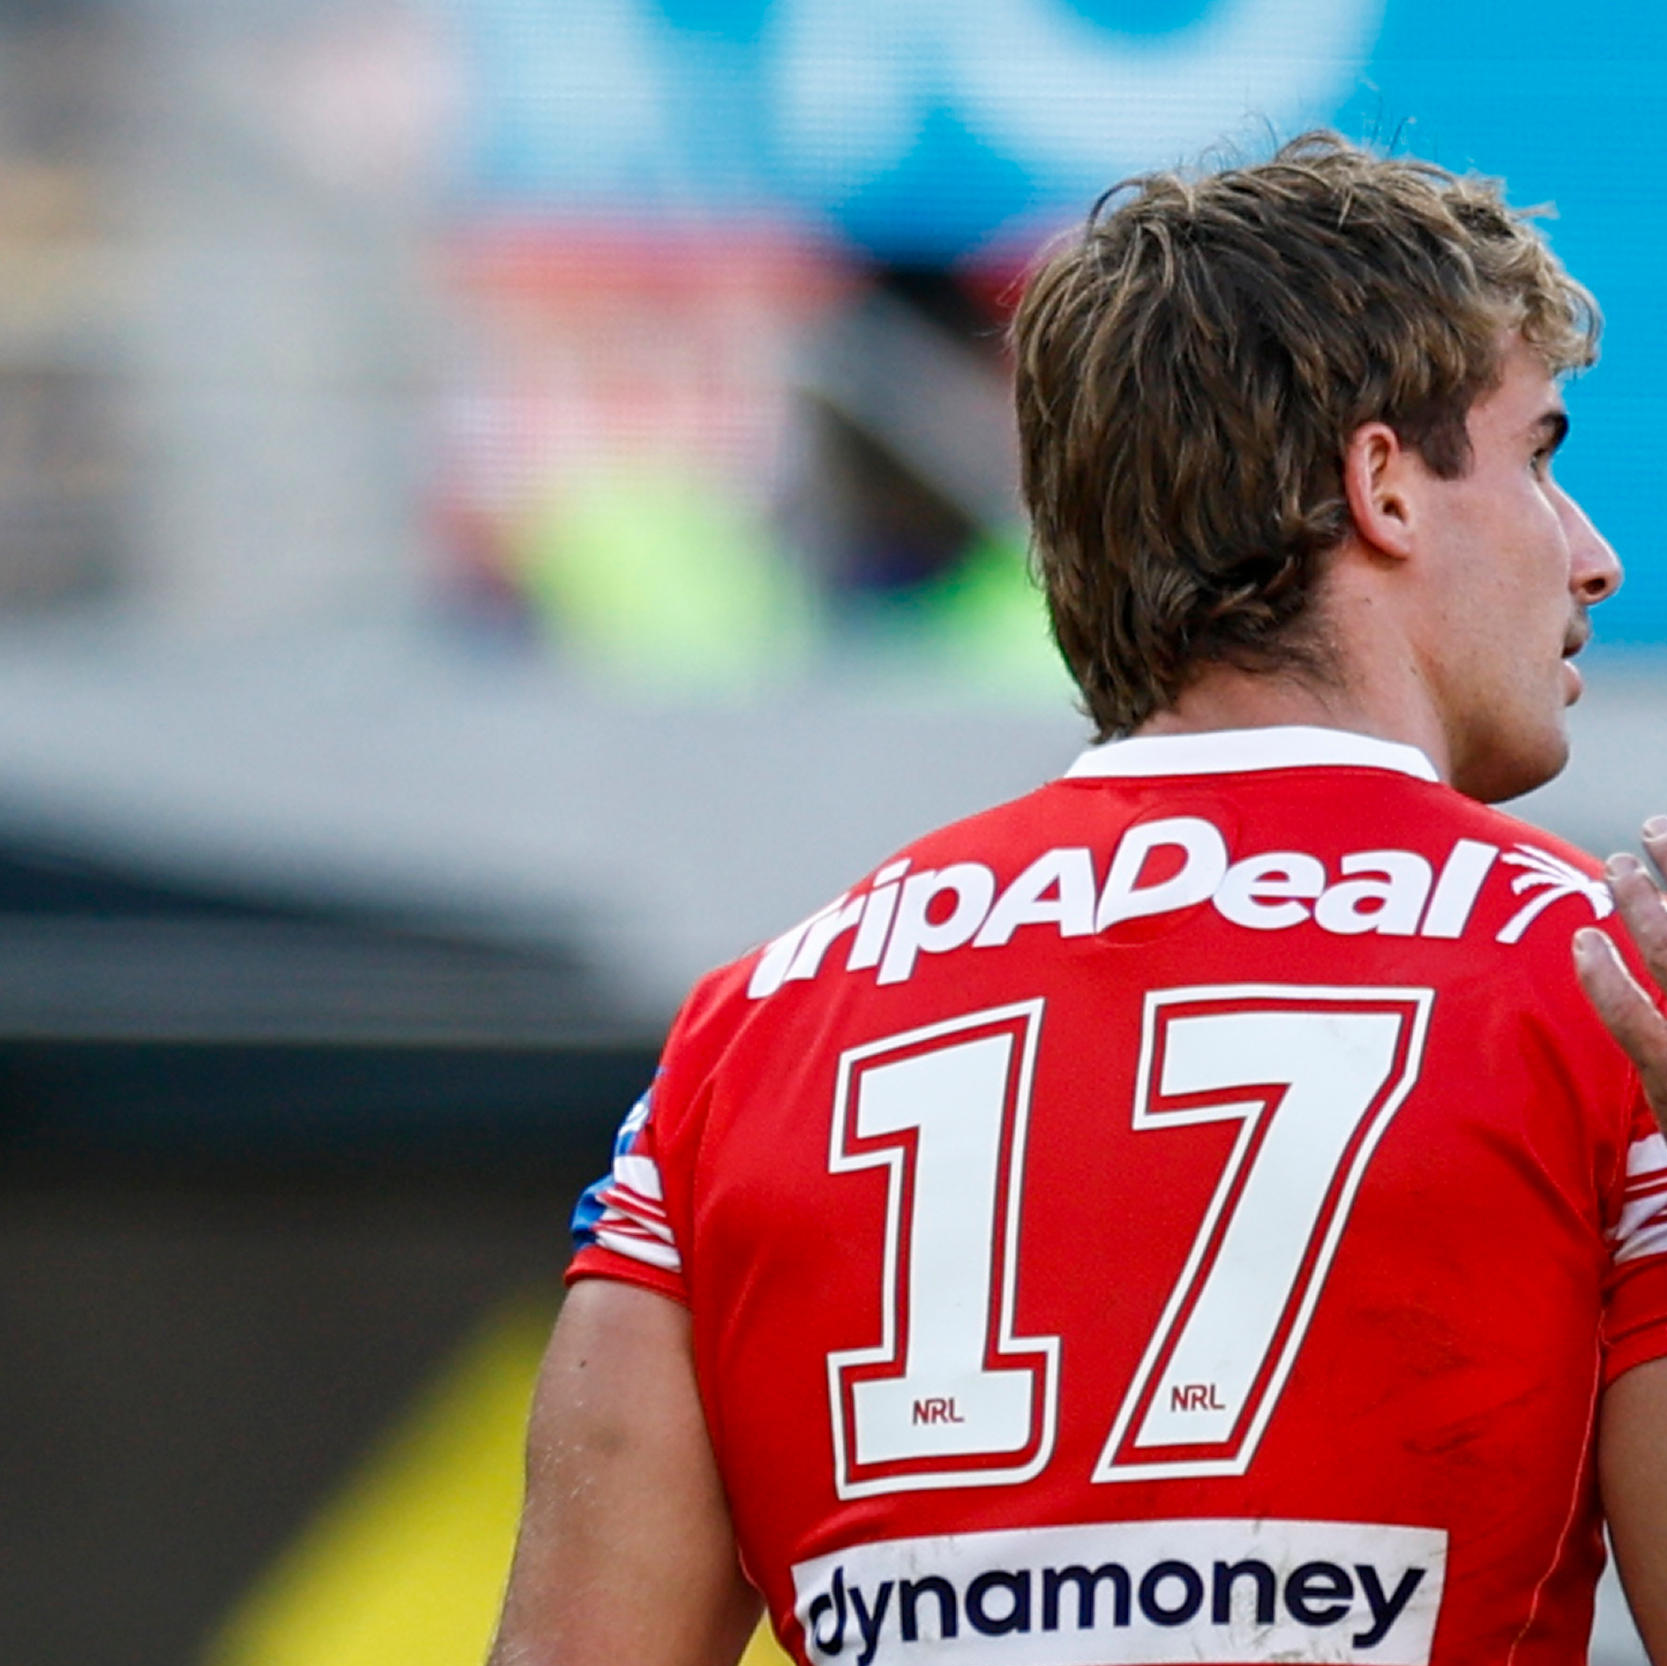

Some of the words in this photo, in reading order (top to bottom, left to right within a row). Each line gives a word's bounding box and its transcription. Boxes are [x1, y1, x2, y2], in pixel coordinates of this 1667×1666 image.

[827, 985, 1435, 1500] 17
[912, 1398, 965, 1426] NRL
[1170, 1384, 1226, 1413] NRL
